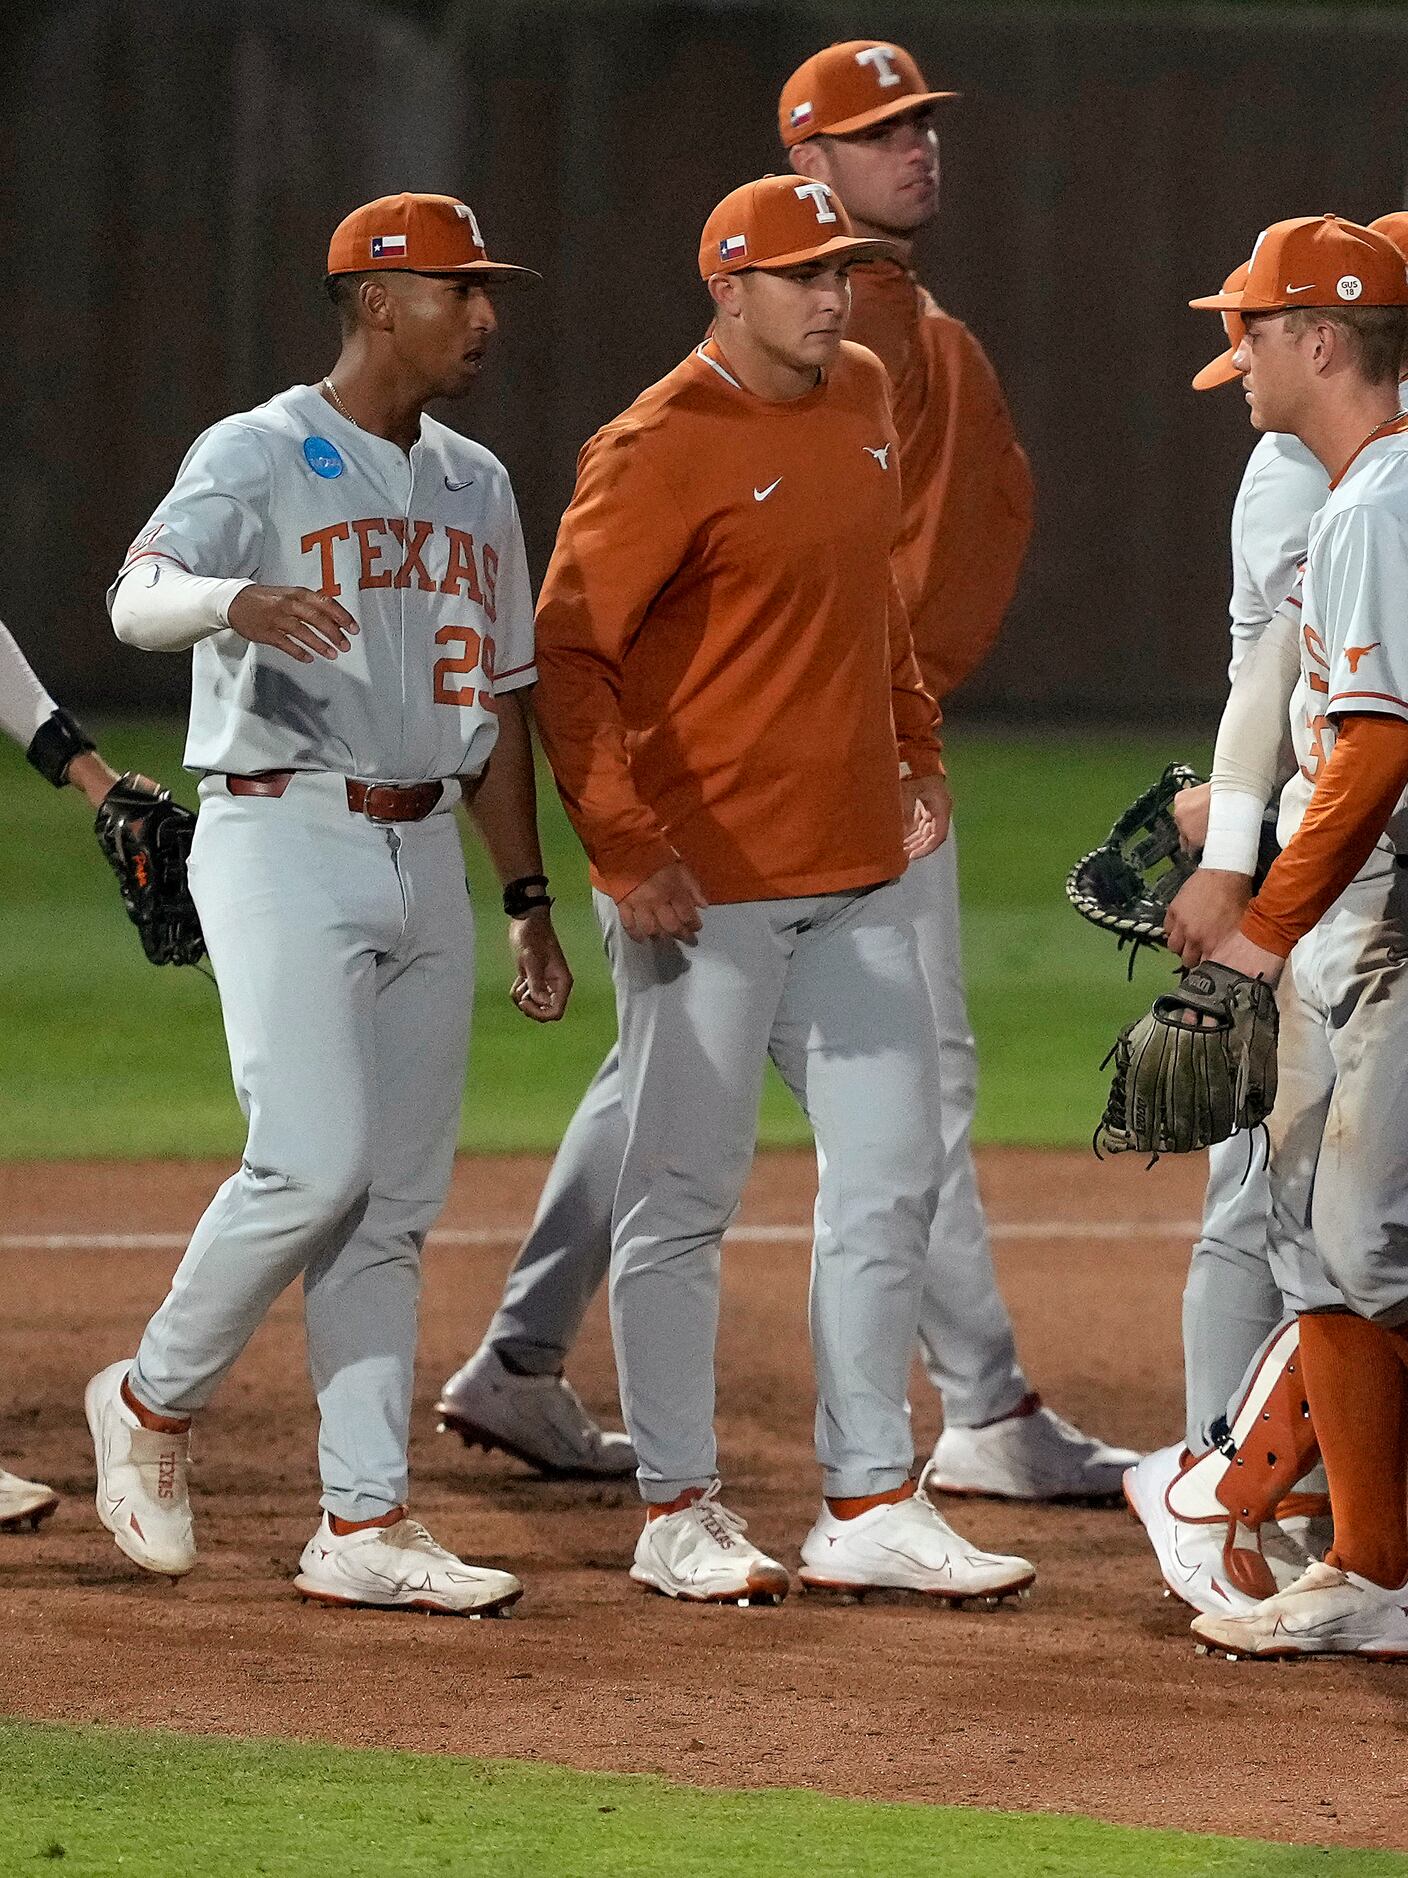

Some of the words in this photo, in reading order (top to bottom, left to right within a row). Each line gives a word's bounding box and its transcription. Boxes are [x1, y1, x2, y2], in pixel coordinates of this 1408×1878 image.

[855, 46, 900, 88] T
[793, 183, 837, 224] T
[1341, 281, 1359, 289] GUS
[301, 517, 499, 623] TEXAS
